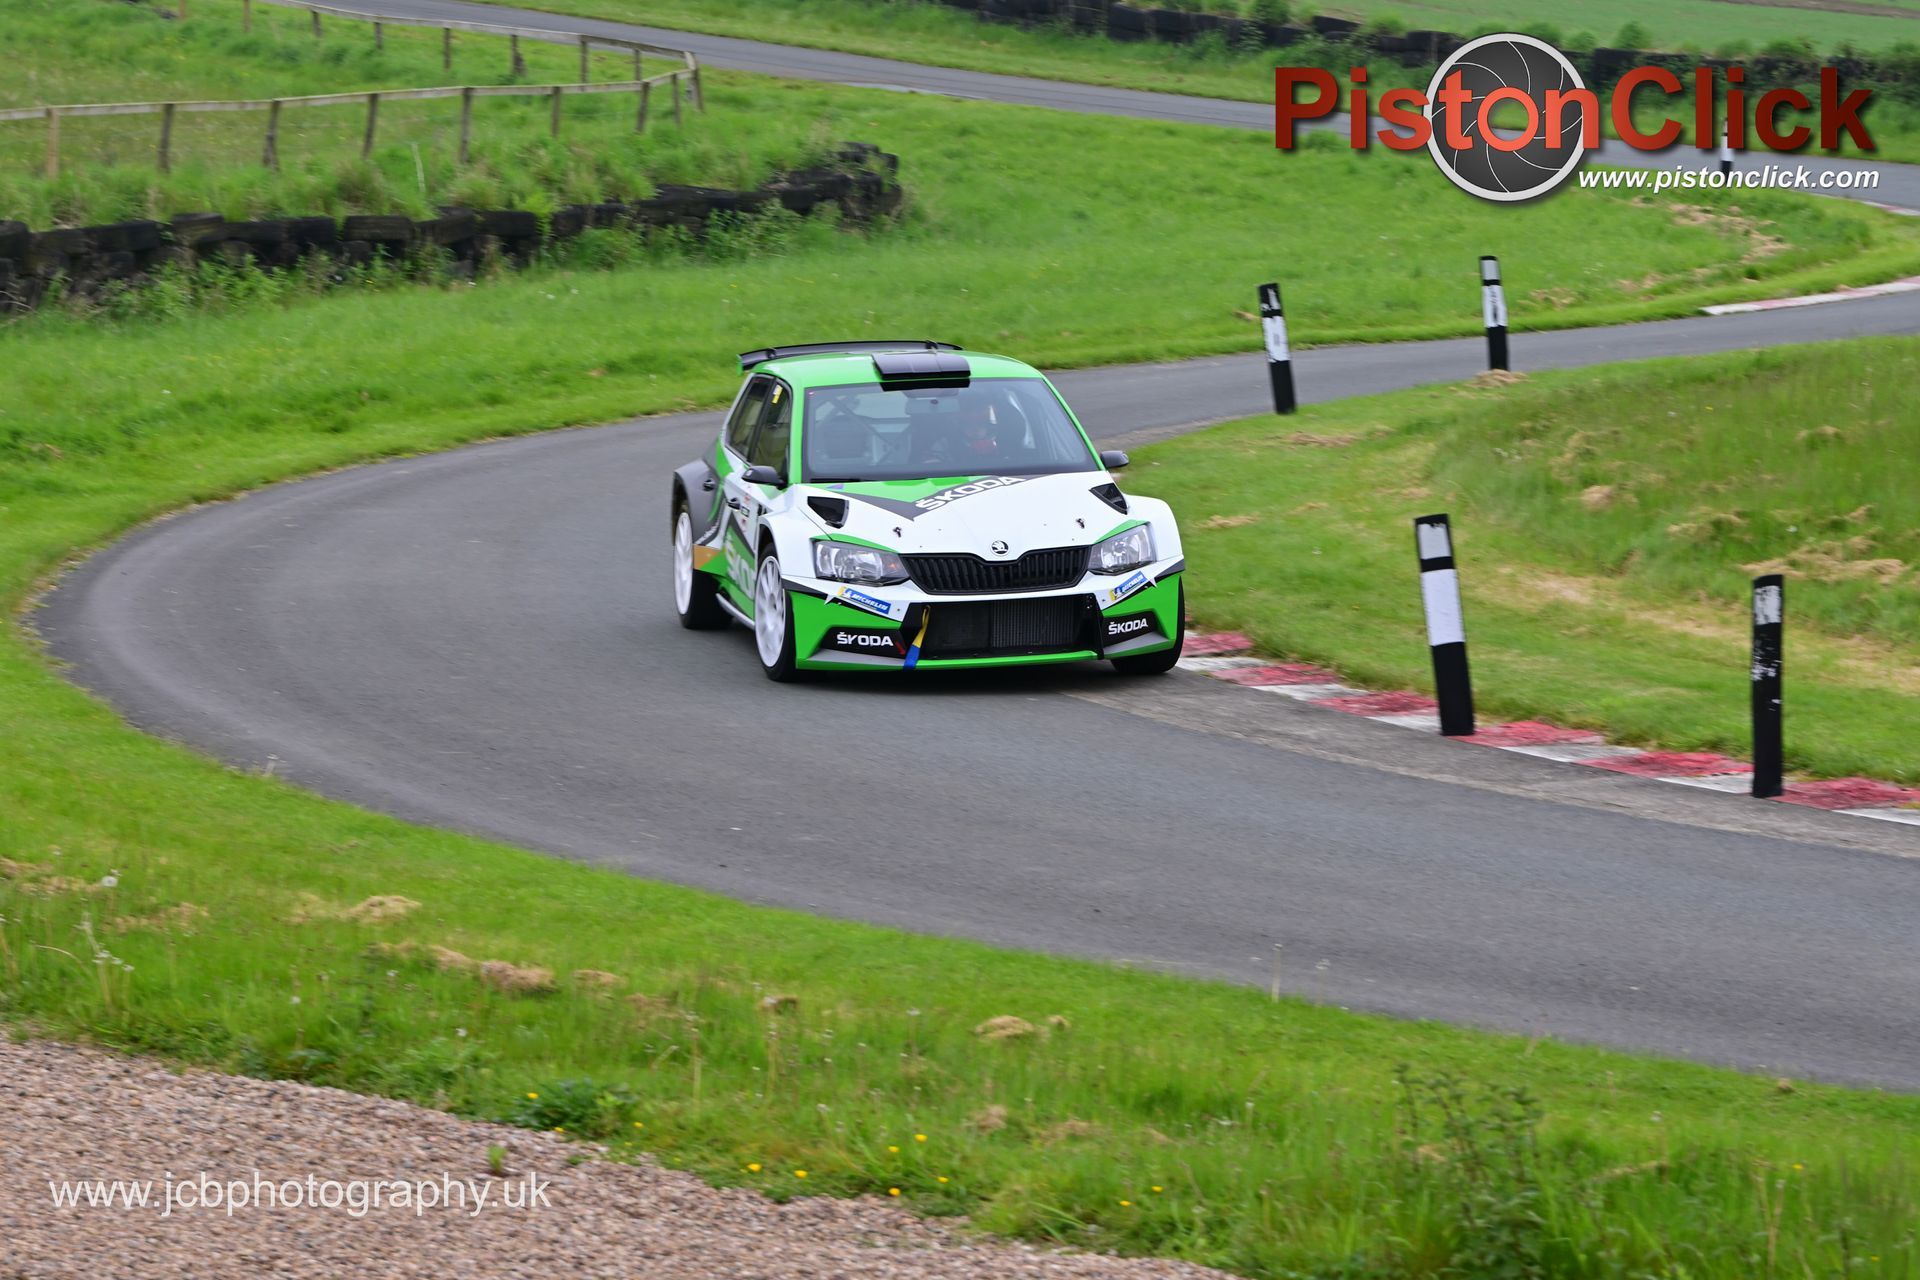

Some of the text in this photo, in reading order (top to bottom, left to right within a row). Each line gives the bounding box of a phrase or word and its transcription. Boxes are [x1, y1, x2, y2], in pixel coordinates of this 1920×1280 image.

[915, 476, 1026, 510] ŠKODA
[724, 531, 756, 601] ŠKO
[850, 593, 889, 611] MICHELIN
[1108, 618, 1149, 635] ŠKODA
[836, 631, 894, 647] ŠKODA
